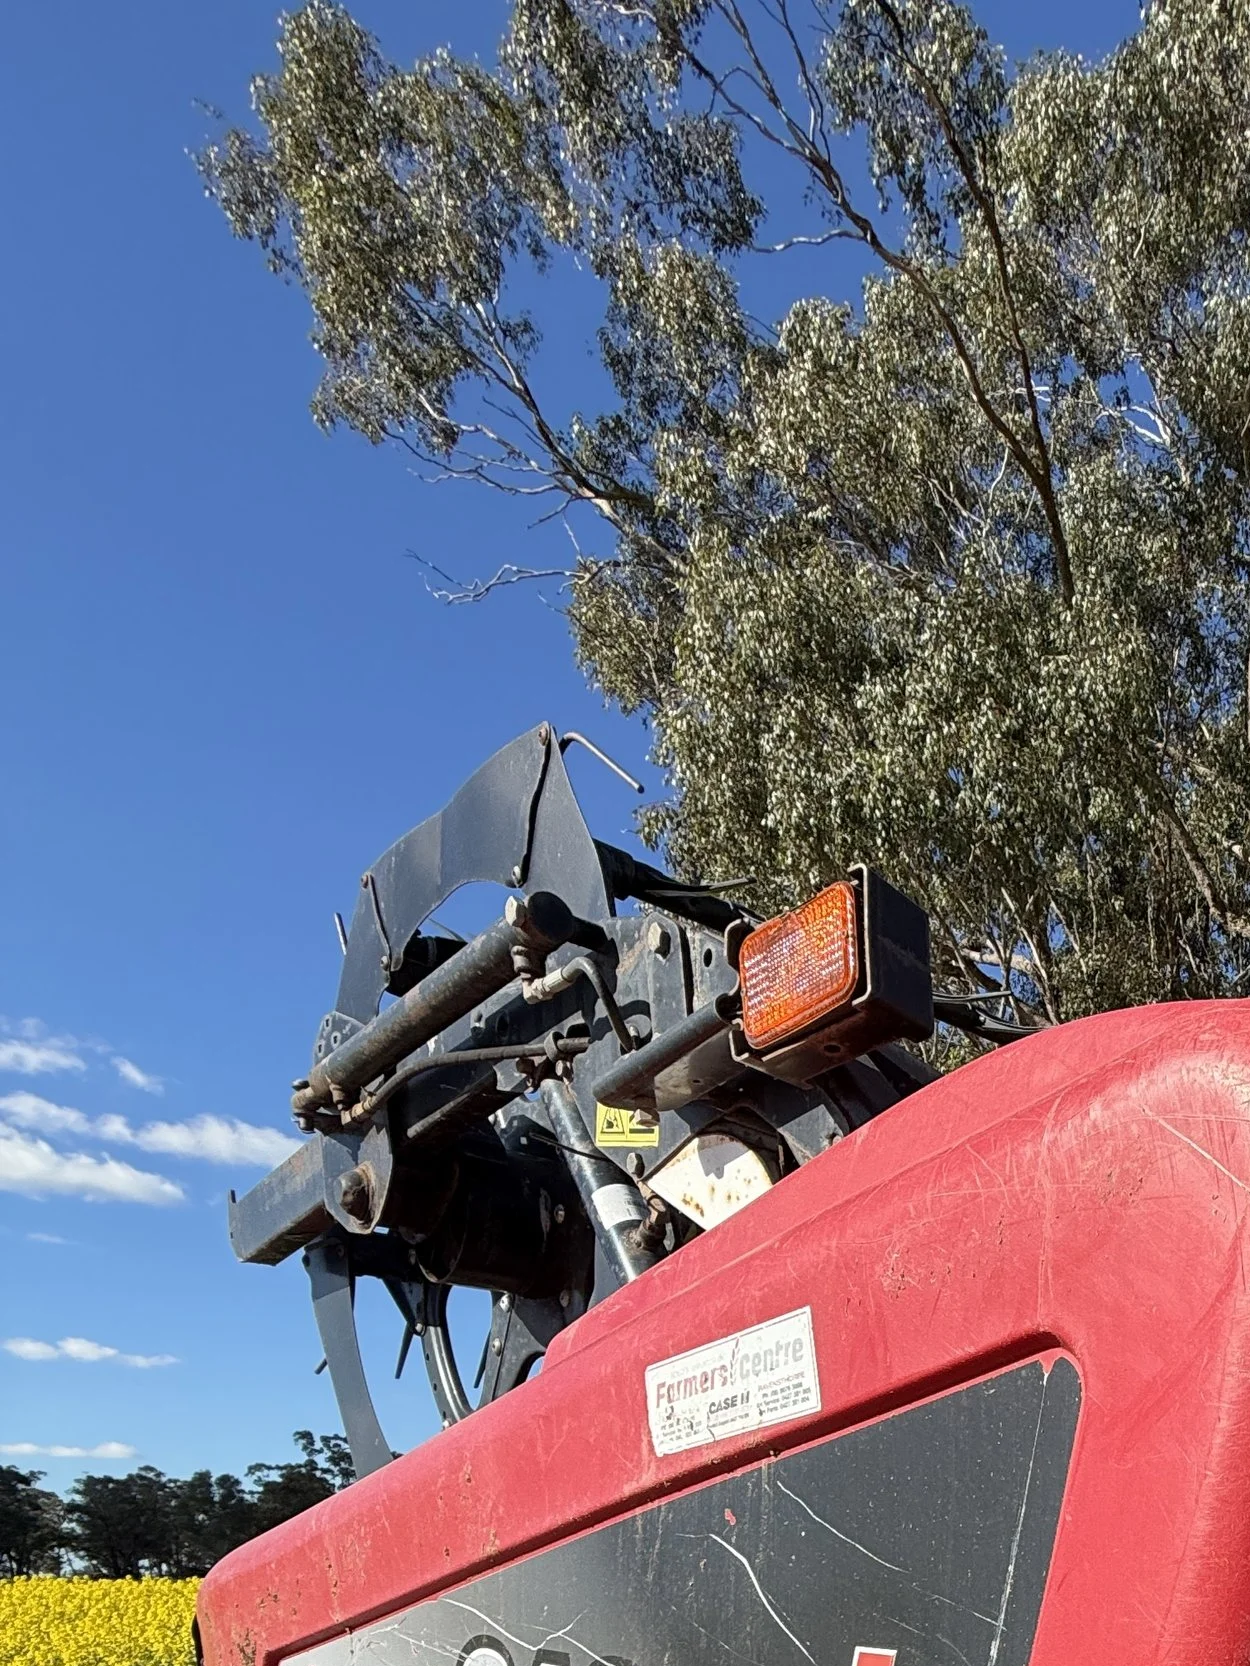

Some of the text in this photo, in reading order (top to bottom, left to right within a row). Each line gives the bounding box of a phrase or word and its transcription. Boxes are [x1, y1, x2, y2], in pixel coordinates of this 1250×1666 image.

[656, 1364, 728, 1408] Farmers
[739, 1337, 804, 1380] Centre
[709, 1395, 738, 1415] CASE
